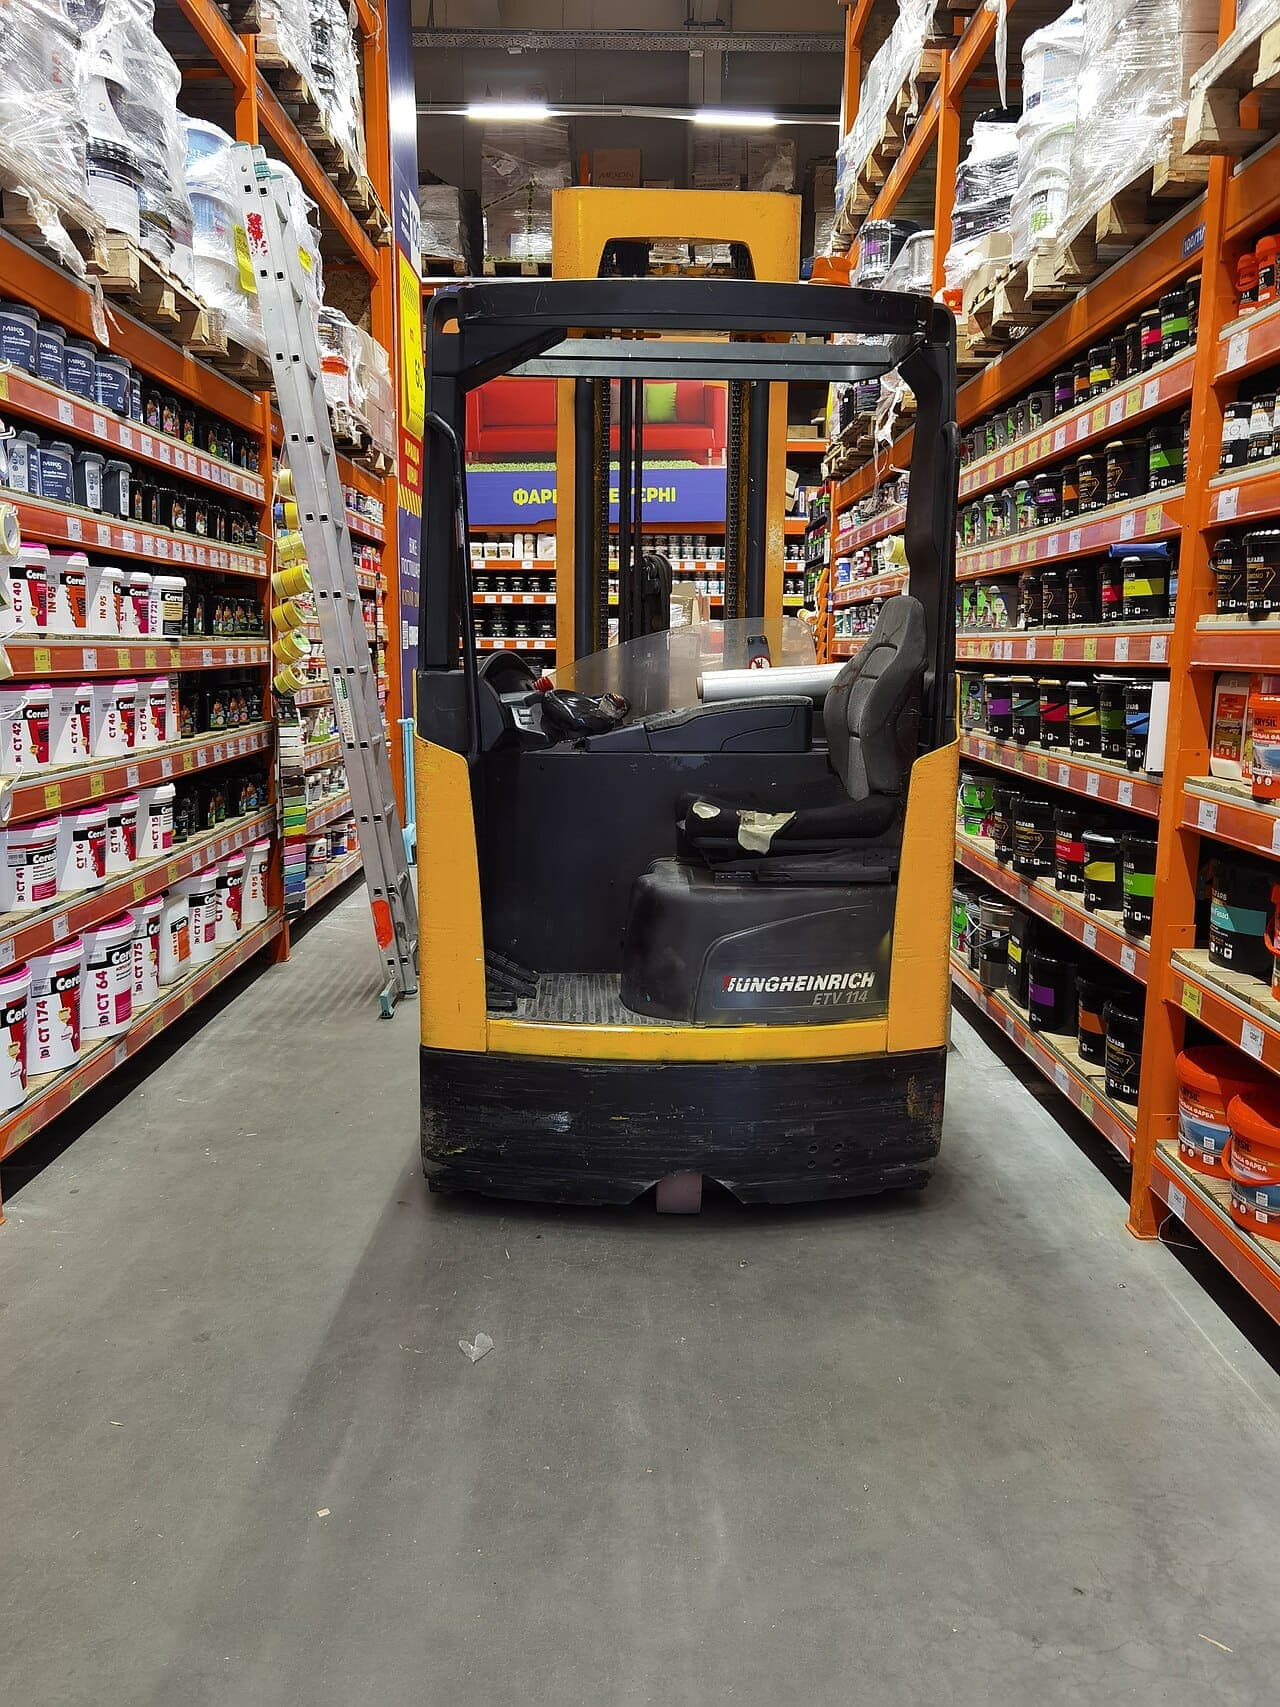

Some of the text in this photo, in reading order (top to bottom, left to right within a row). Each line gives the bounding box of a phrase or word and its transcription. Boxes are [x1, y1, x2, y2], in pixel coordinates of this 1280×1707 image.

[512, 488, 558, 505] ФАР
[96, 970, 108, 989] 64
[134, 965, 143, 979] CT
[97, 994, 109, 1011] CT
[812, 990, 868, 1006] ETV 114
[36, 1000, 48, 1024] 174
[38, 1028, 50, 1042] CT
